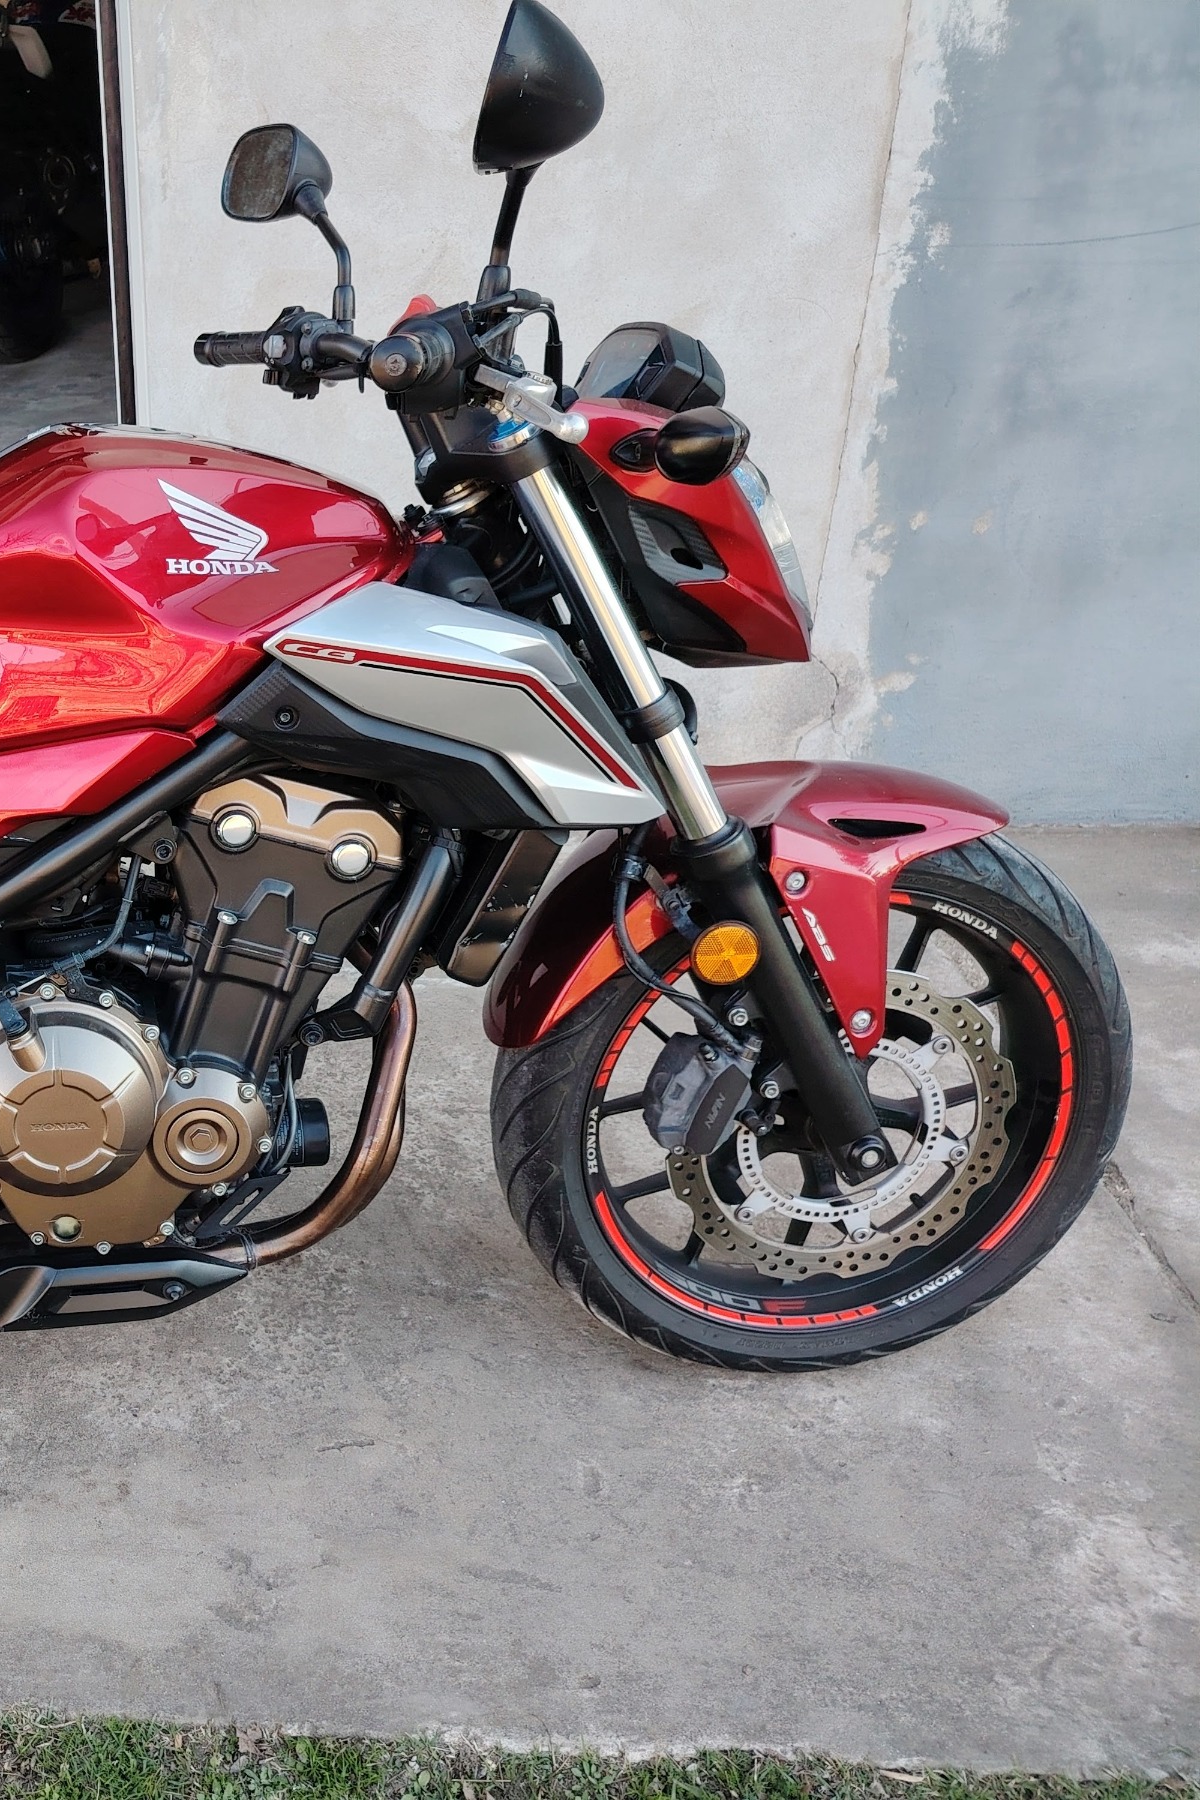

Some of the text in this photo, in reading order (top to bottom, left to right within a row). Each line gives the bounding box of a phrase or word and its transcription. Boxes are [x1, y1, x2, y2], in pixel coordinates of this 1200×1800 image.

[166, 558, 280, 575] HONDA
[801, 907, 835, 962] ABS
[931, 901, 999, 940] HONDA
[30, 1121, 91, 1133] HONDA
[586, 1105, 600, 1176] HONDA
[892, 1265, 964, 1307] HONDA
